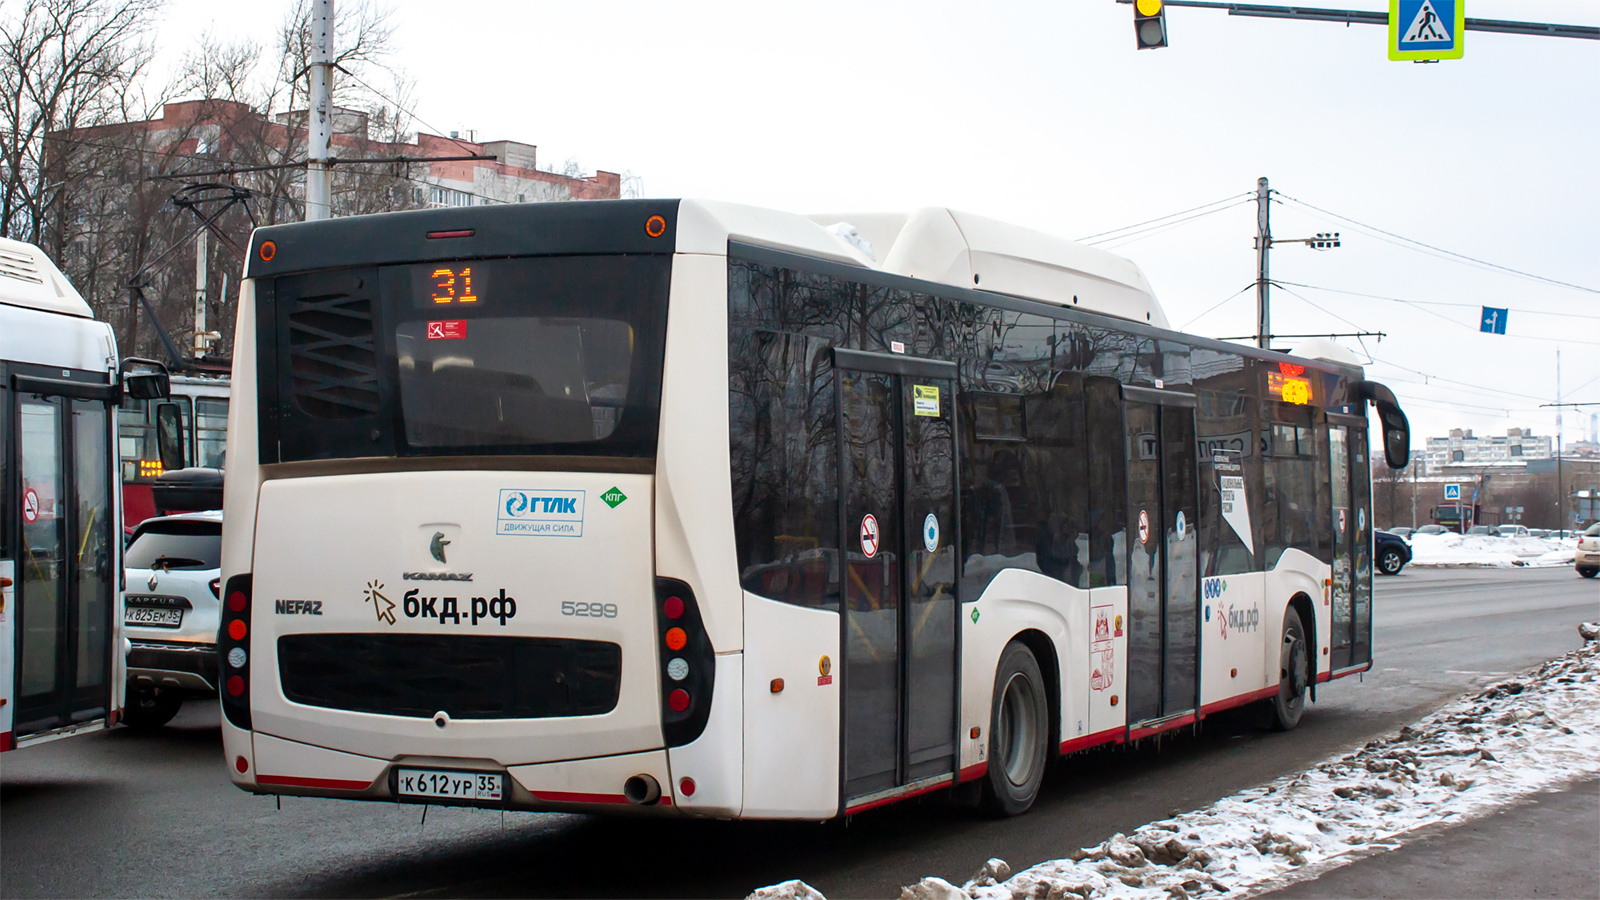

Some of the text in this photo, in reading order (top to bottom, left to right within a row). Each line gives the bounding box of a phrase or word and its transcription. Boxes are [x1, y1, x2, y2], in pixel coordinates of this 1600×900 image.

[431, 267, 477, 304] 31
[530, 497, 577, 513] ГТЛК
[605, 493, 623, 501] КПГ
[504, 523, 575, 533] ДВИЖУЩАЯ СИЛА
[402, 572, 474, 582] KAMAZ
[127, 597, 175, 605] KAPTUR
[275, 599, 323, 616] NEFAZ
[403, 588, 517, 626] бкд.рф
[561, 600, 618, 619] 5299
[1228, 601, 1259, 633] бкд.рф
[478, 775, 496, 791] 35
